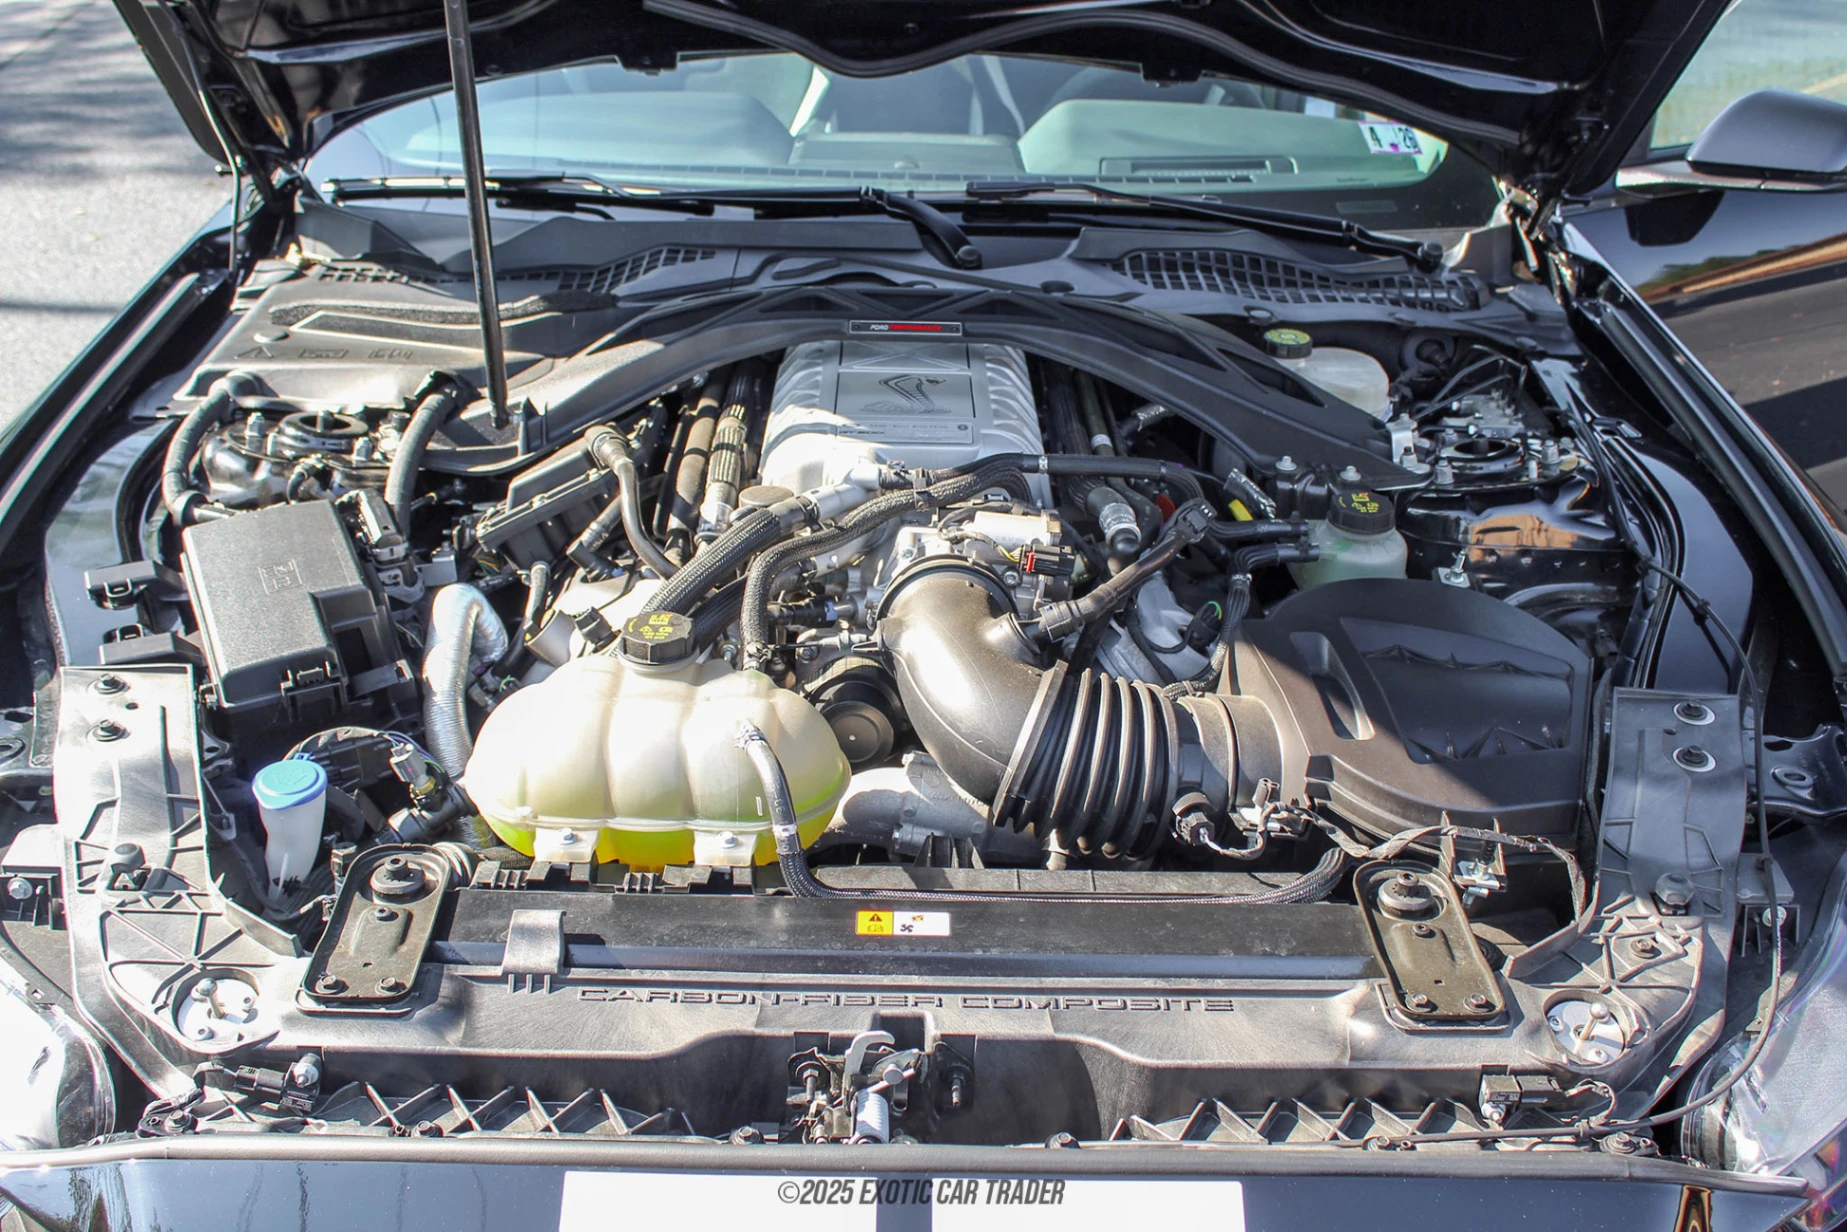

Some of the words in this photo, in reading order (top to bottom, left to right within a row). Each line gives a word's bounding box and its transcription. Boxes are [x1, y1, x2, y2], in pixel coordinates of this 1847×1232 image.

[1368, 126, 1383, 148] 4
[578, 988, 943, 1007] CARBON-FIBER
[959, 994, 1235, 1012] COMPOSITE
